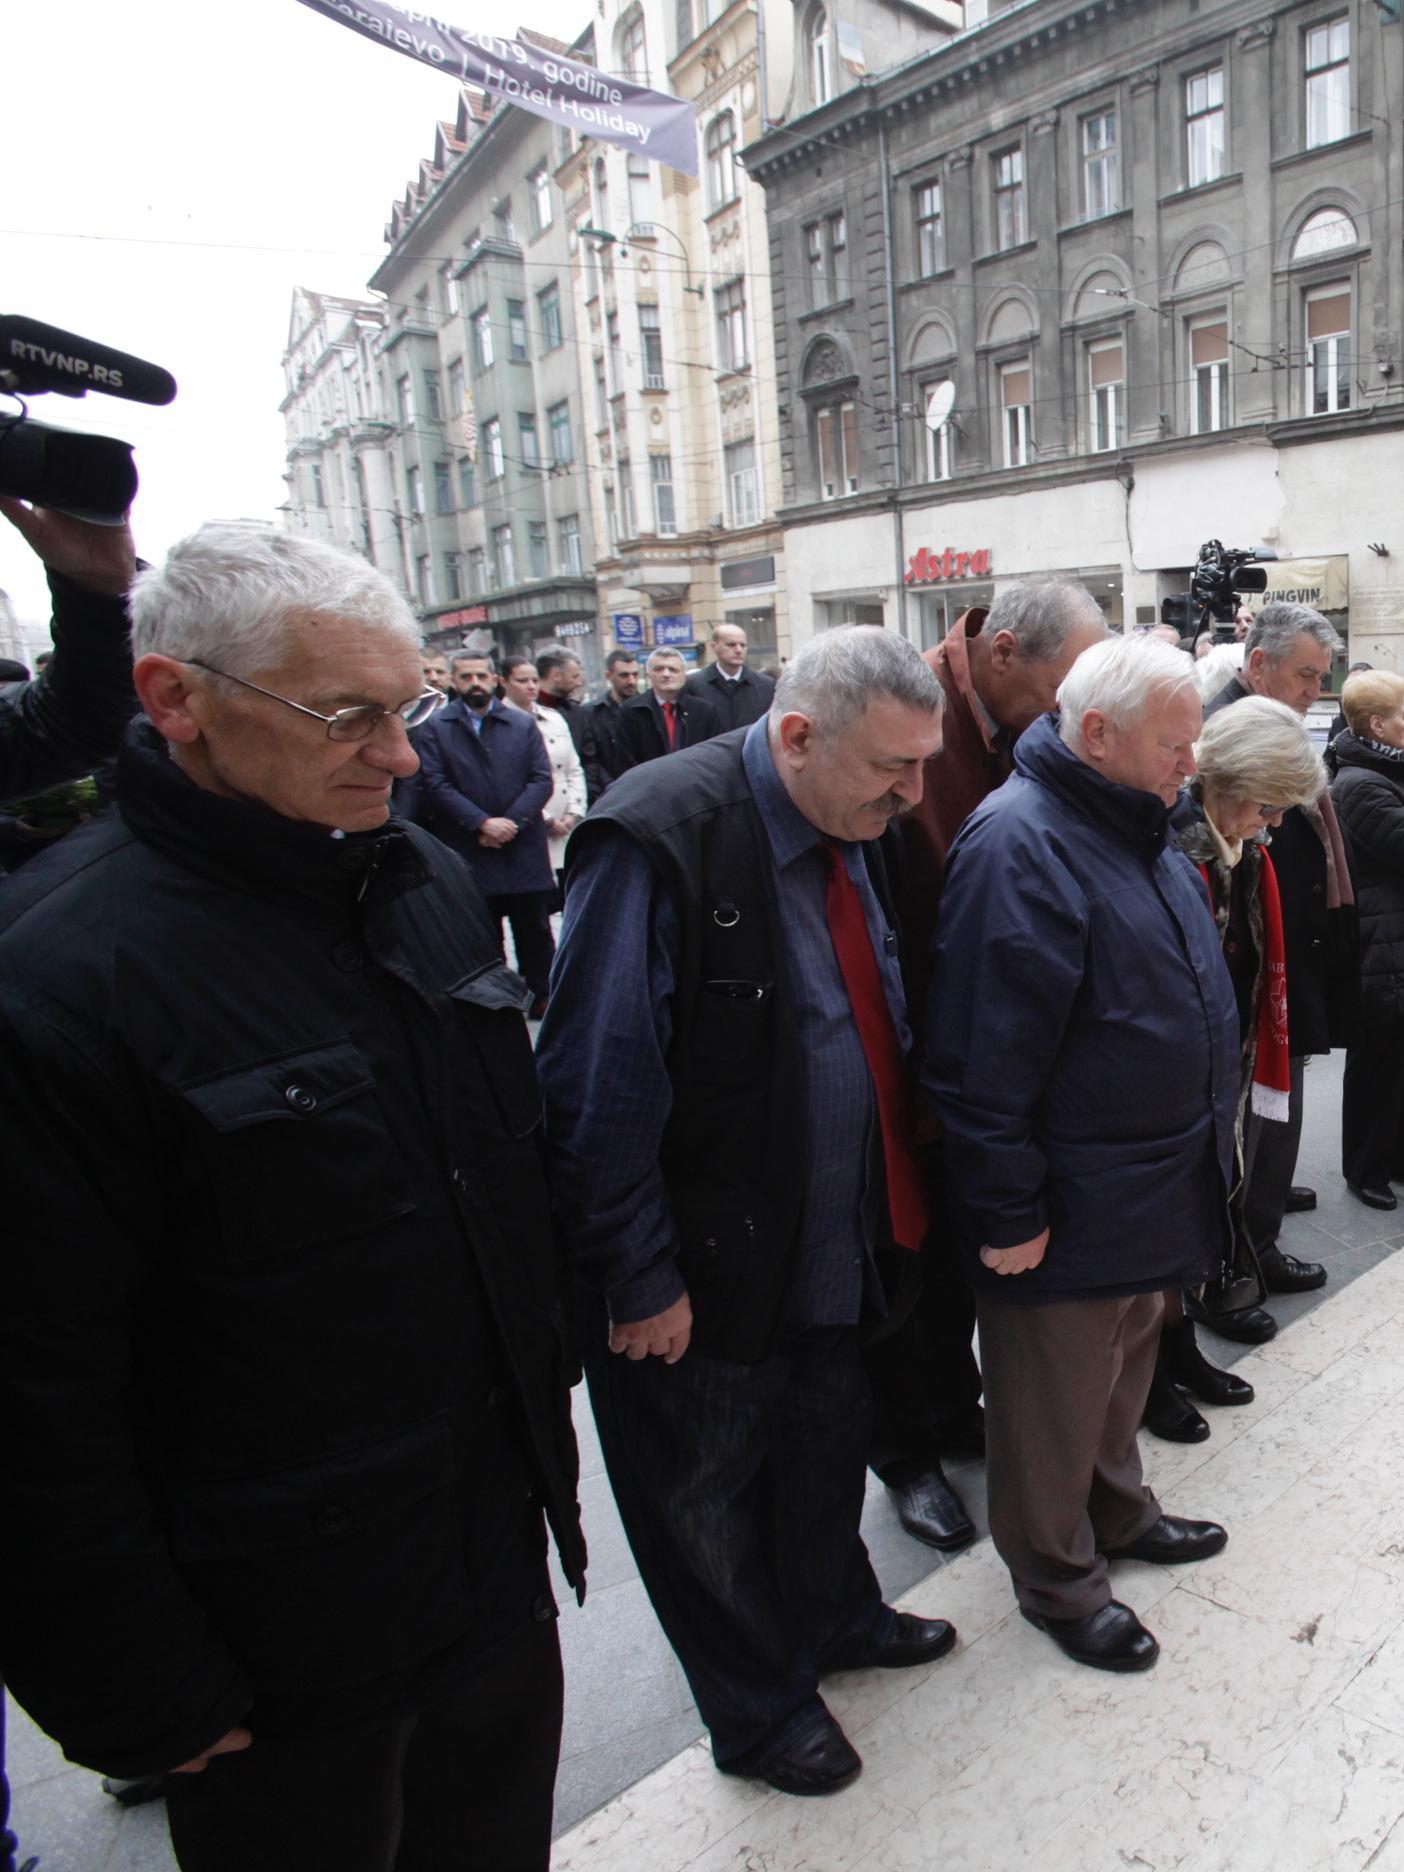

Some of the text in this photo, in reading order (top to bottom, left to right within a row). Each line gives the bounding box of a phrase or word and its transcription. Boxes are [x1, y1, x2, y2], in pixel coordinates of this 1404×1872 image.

[484, 62, 553, 109] Hotel
[559, 94, 652, 145] Holiday
[542, 59, 623, 107] godine
[10, 338, 125, 388] RTVNP.RS
[903, 547, 991, 584] Astra
[1262, 588, 1321, 605] PINGVIN
